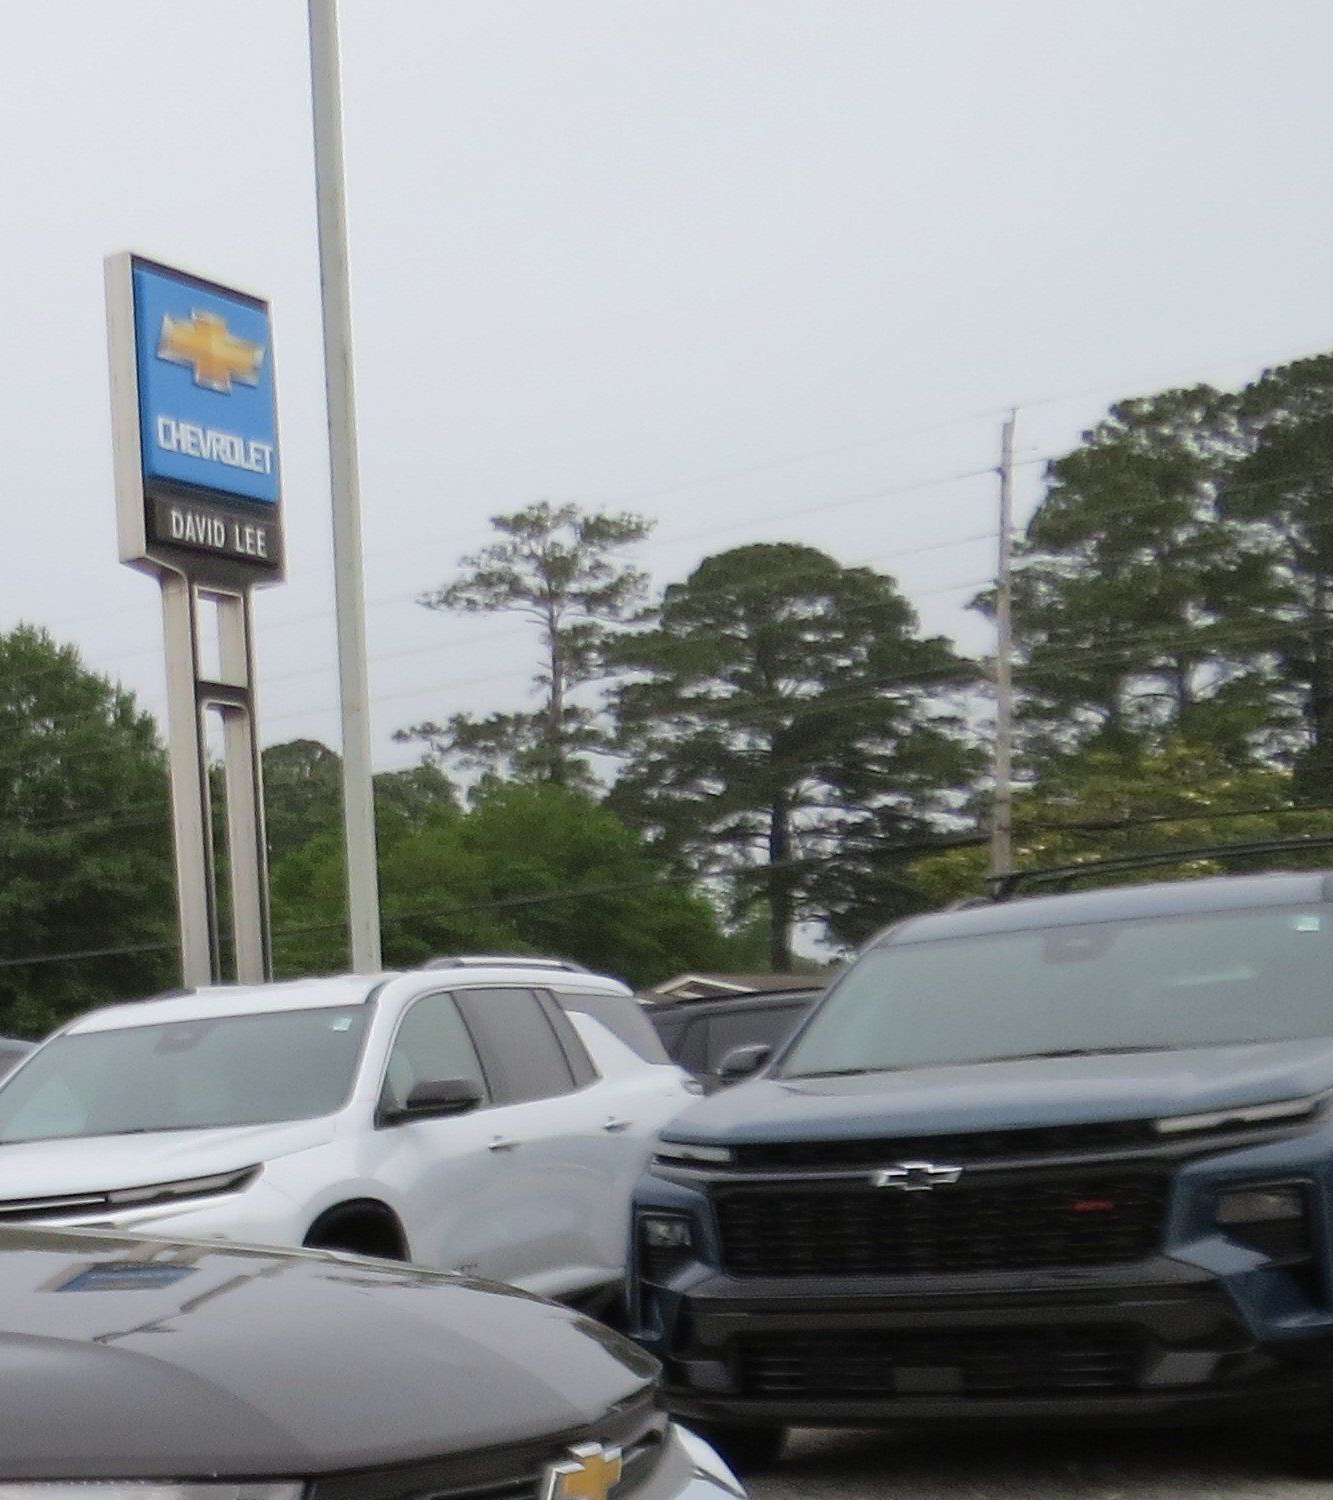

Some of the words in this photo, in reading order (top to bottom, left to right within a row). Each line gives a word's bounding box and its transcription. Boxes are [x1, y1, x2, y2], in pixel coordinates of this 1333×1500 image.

[157, 416, 272, 474] CHEVROLET
[171, 510, 226, 548] DAVID
[234, 525, 268, 558] LEE
